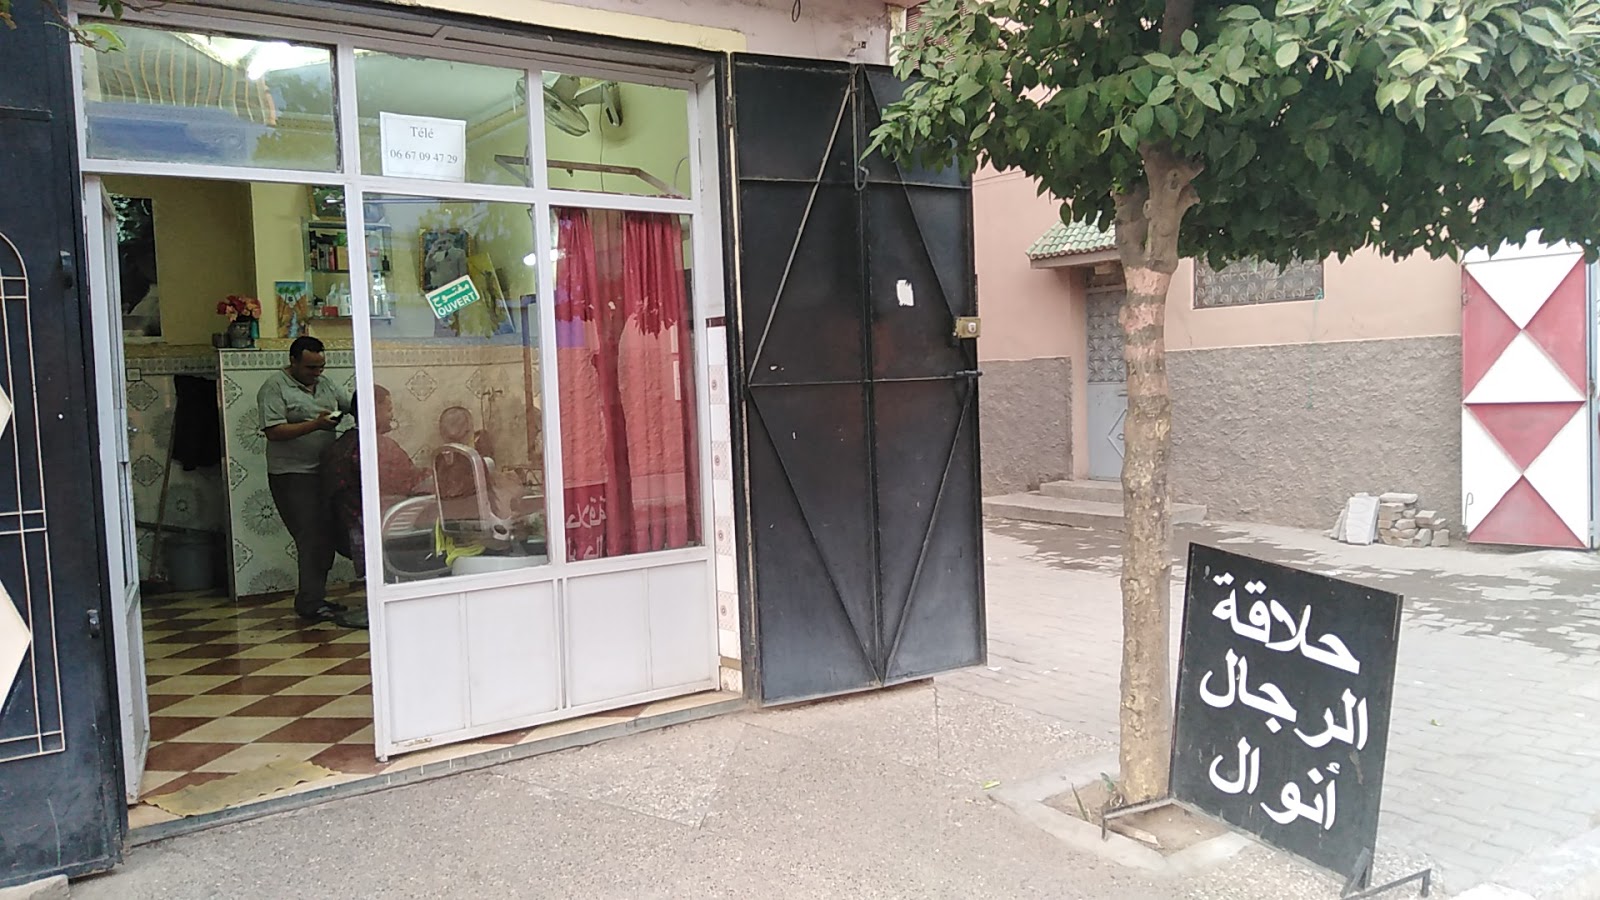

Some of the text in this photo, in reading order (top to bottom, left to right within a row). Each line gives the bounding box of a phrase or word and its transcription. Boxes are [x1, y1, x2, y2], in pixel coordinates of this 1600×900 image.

[410, 126, 434, 139] Télé
[390, 149, 458, 164] 06 67 09 47 29
[432, 284, 469, 307] مفتوح
[438, 292, 476, 316] OUVERT
[1212, 572, 1361, 675] حلاقة
[1200, 648, 1368, 750] الرجال
